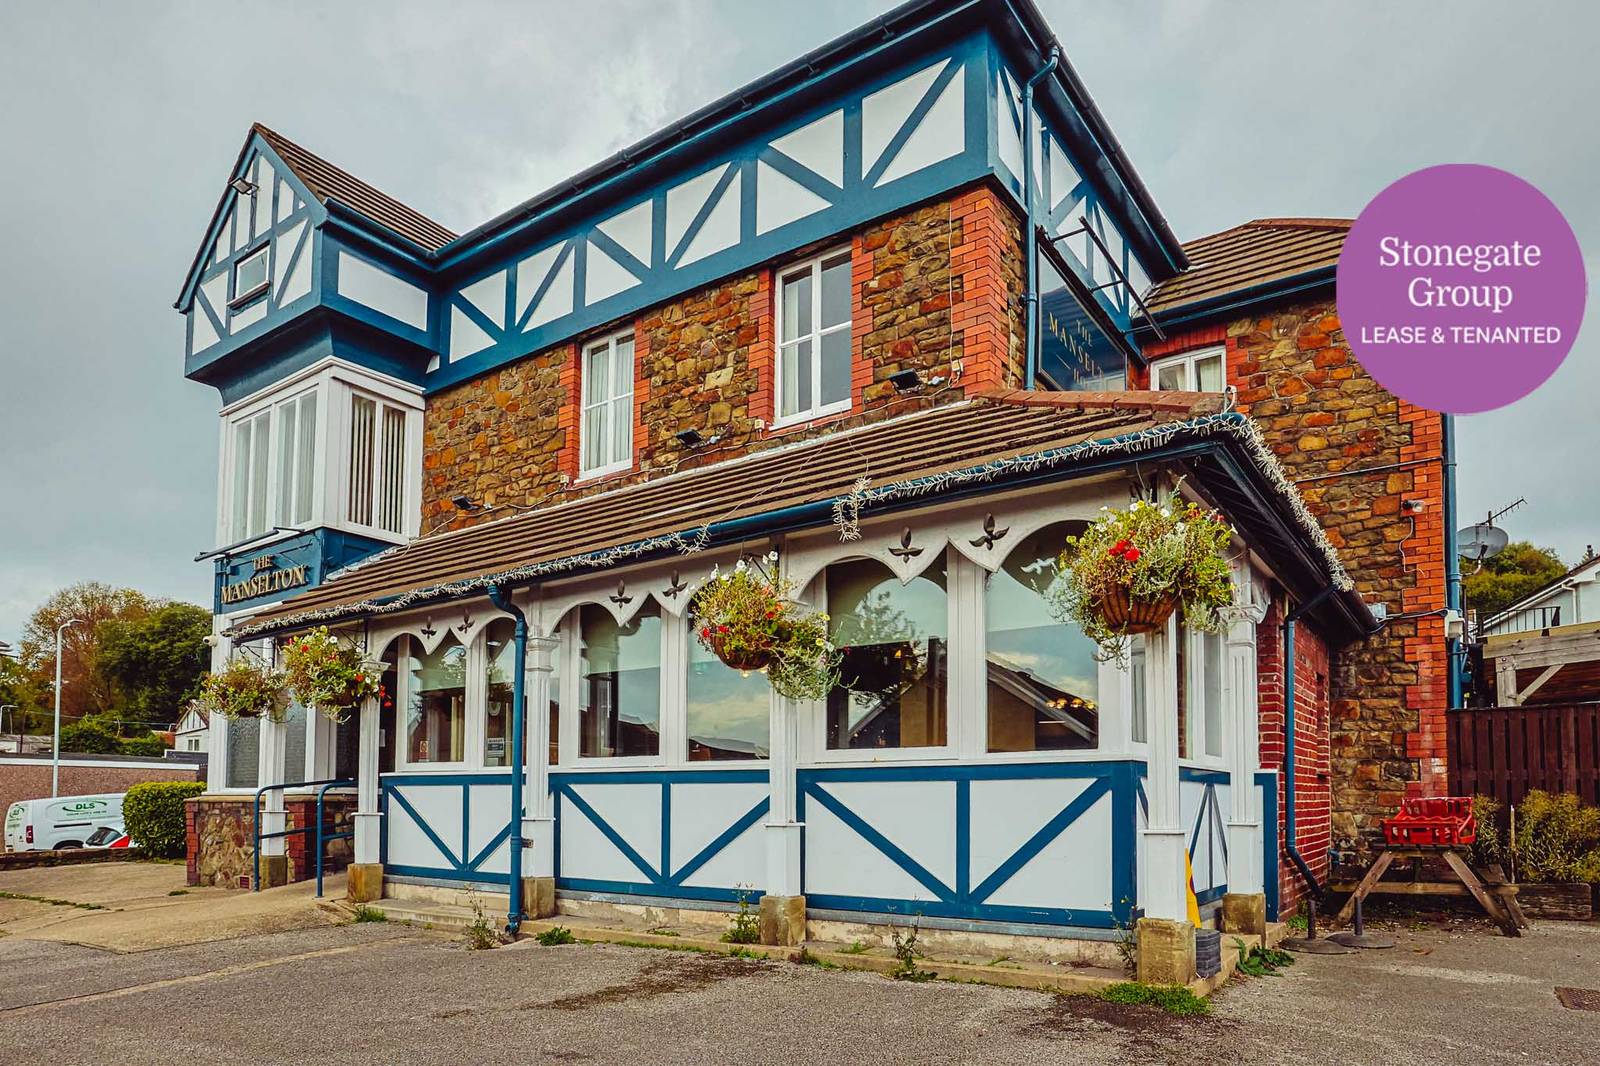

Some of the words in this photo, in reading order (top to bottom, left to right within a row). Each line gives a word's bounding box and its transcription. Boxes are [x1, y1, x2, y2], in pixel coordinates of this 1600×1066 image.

[253, 554, 273, 571] THE
[221, 564, 308, 604] MANSELTON
[75, 802, 96, 810] DLS
